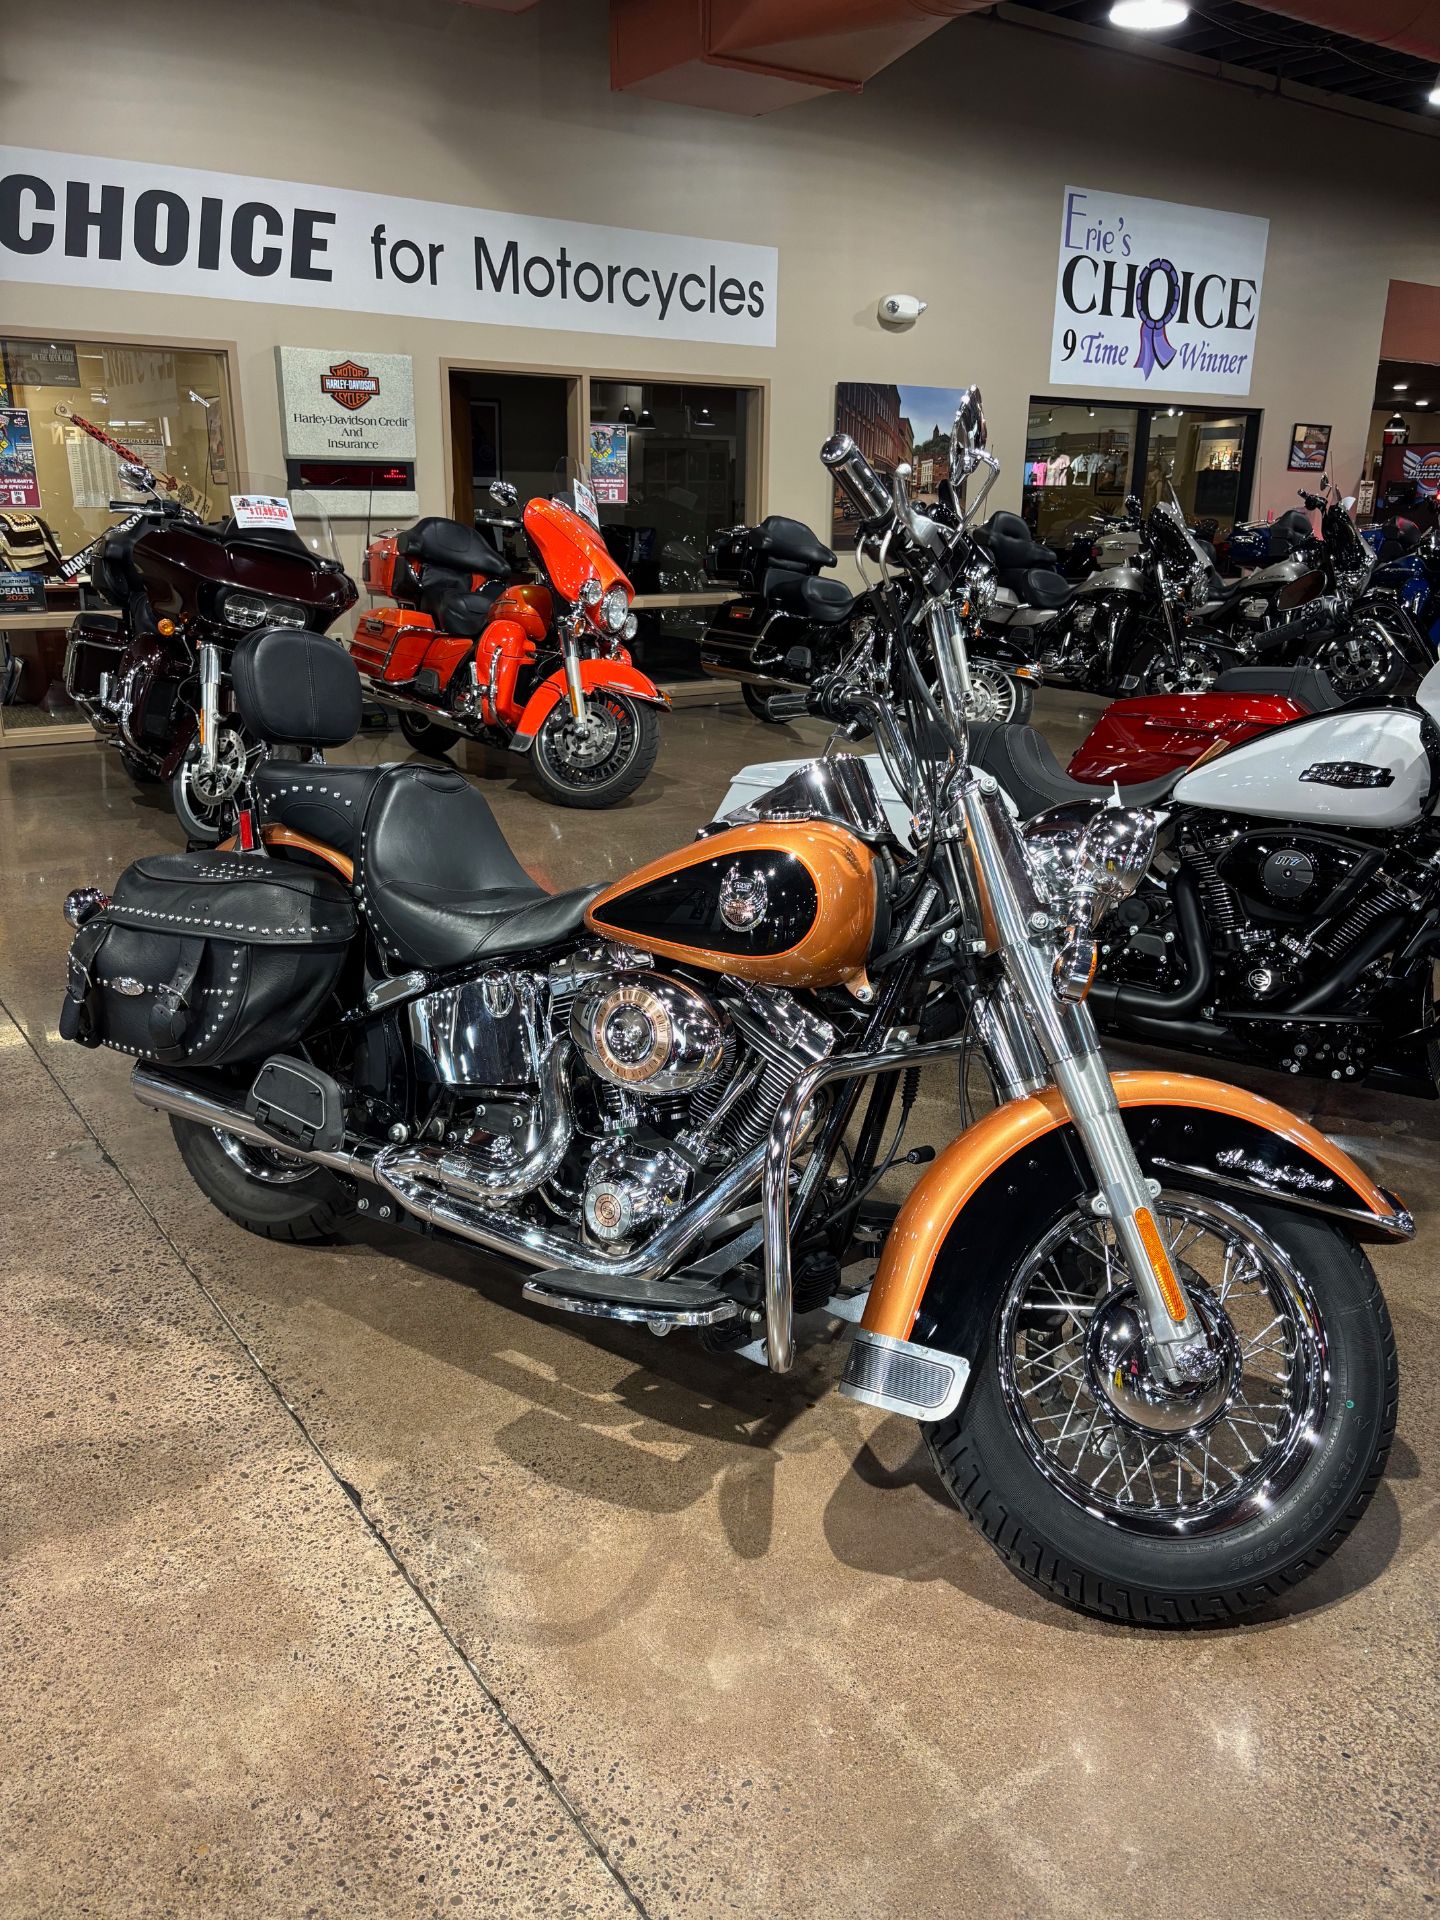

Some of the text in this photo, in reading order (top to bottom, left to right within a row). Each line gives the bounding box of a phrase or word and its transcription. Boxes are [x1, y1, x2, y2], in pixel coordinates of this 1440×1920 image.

[1064, 192, 1132, 257] Erie's
[0, 173, 765, 321] CHOICE for Motorcycles
[1062, 255, 1257, 331] CHOICE
[1061, 328, 1248, 375] 9 Time Winner
[336, 368, 364, 378] MOTOR
[325, 378, 376, 391] HARLEY-DAVIDSON
[338, 392, 367, 406] CYCLES
[293, 413, 408, 427] Harley-Davidson Credit
[341, 427, 363, 437] And
[328, 438, 379, 450] Insurance
[0, 587, 35, 595] DEALER
